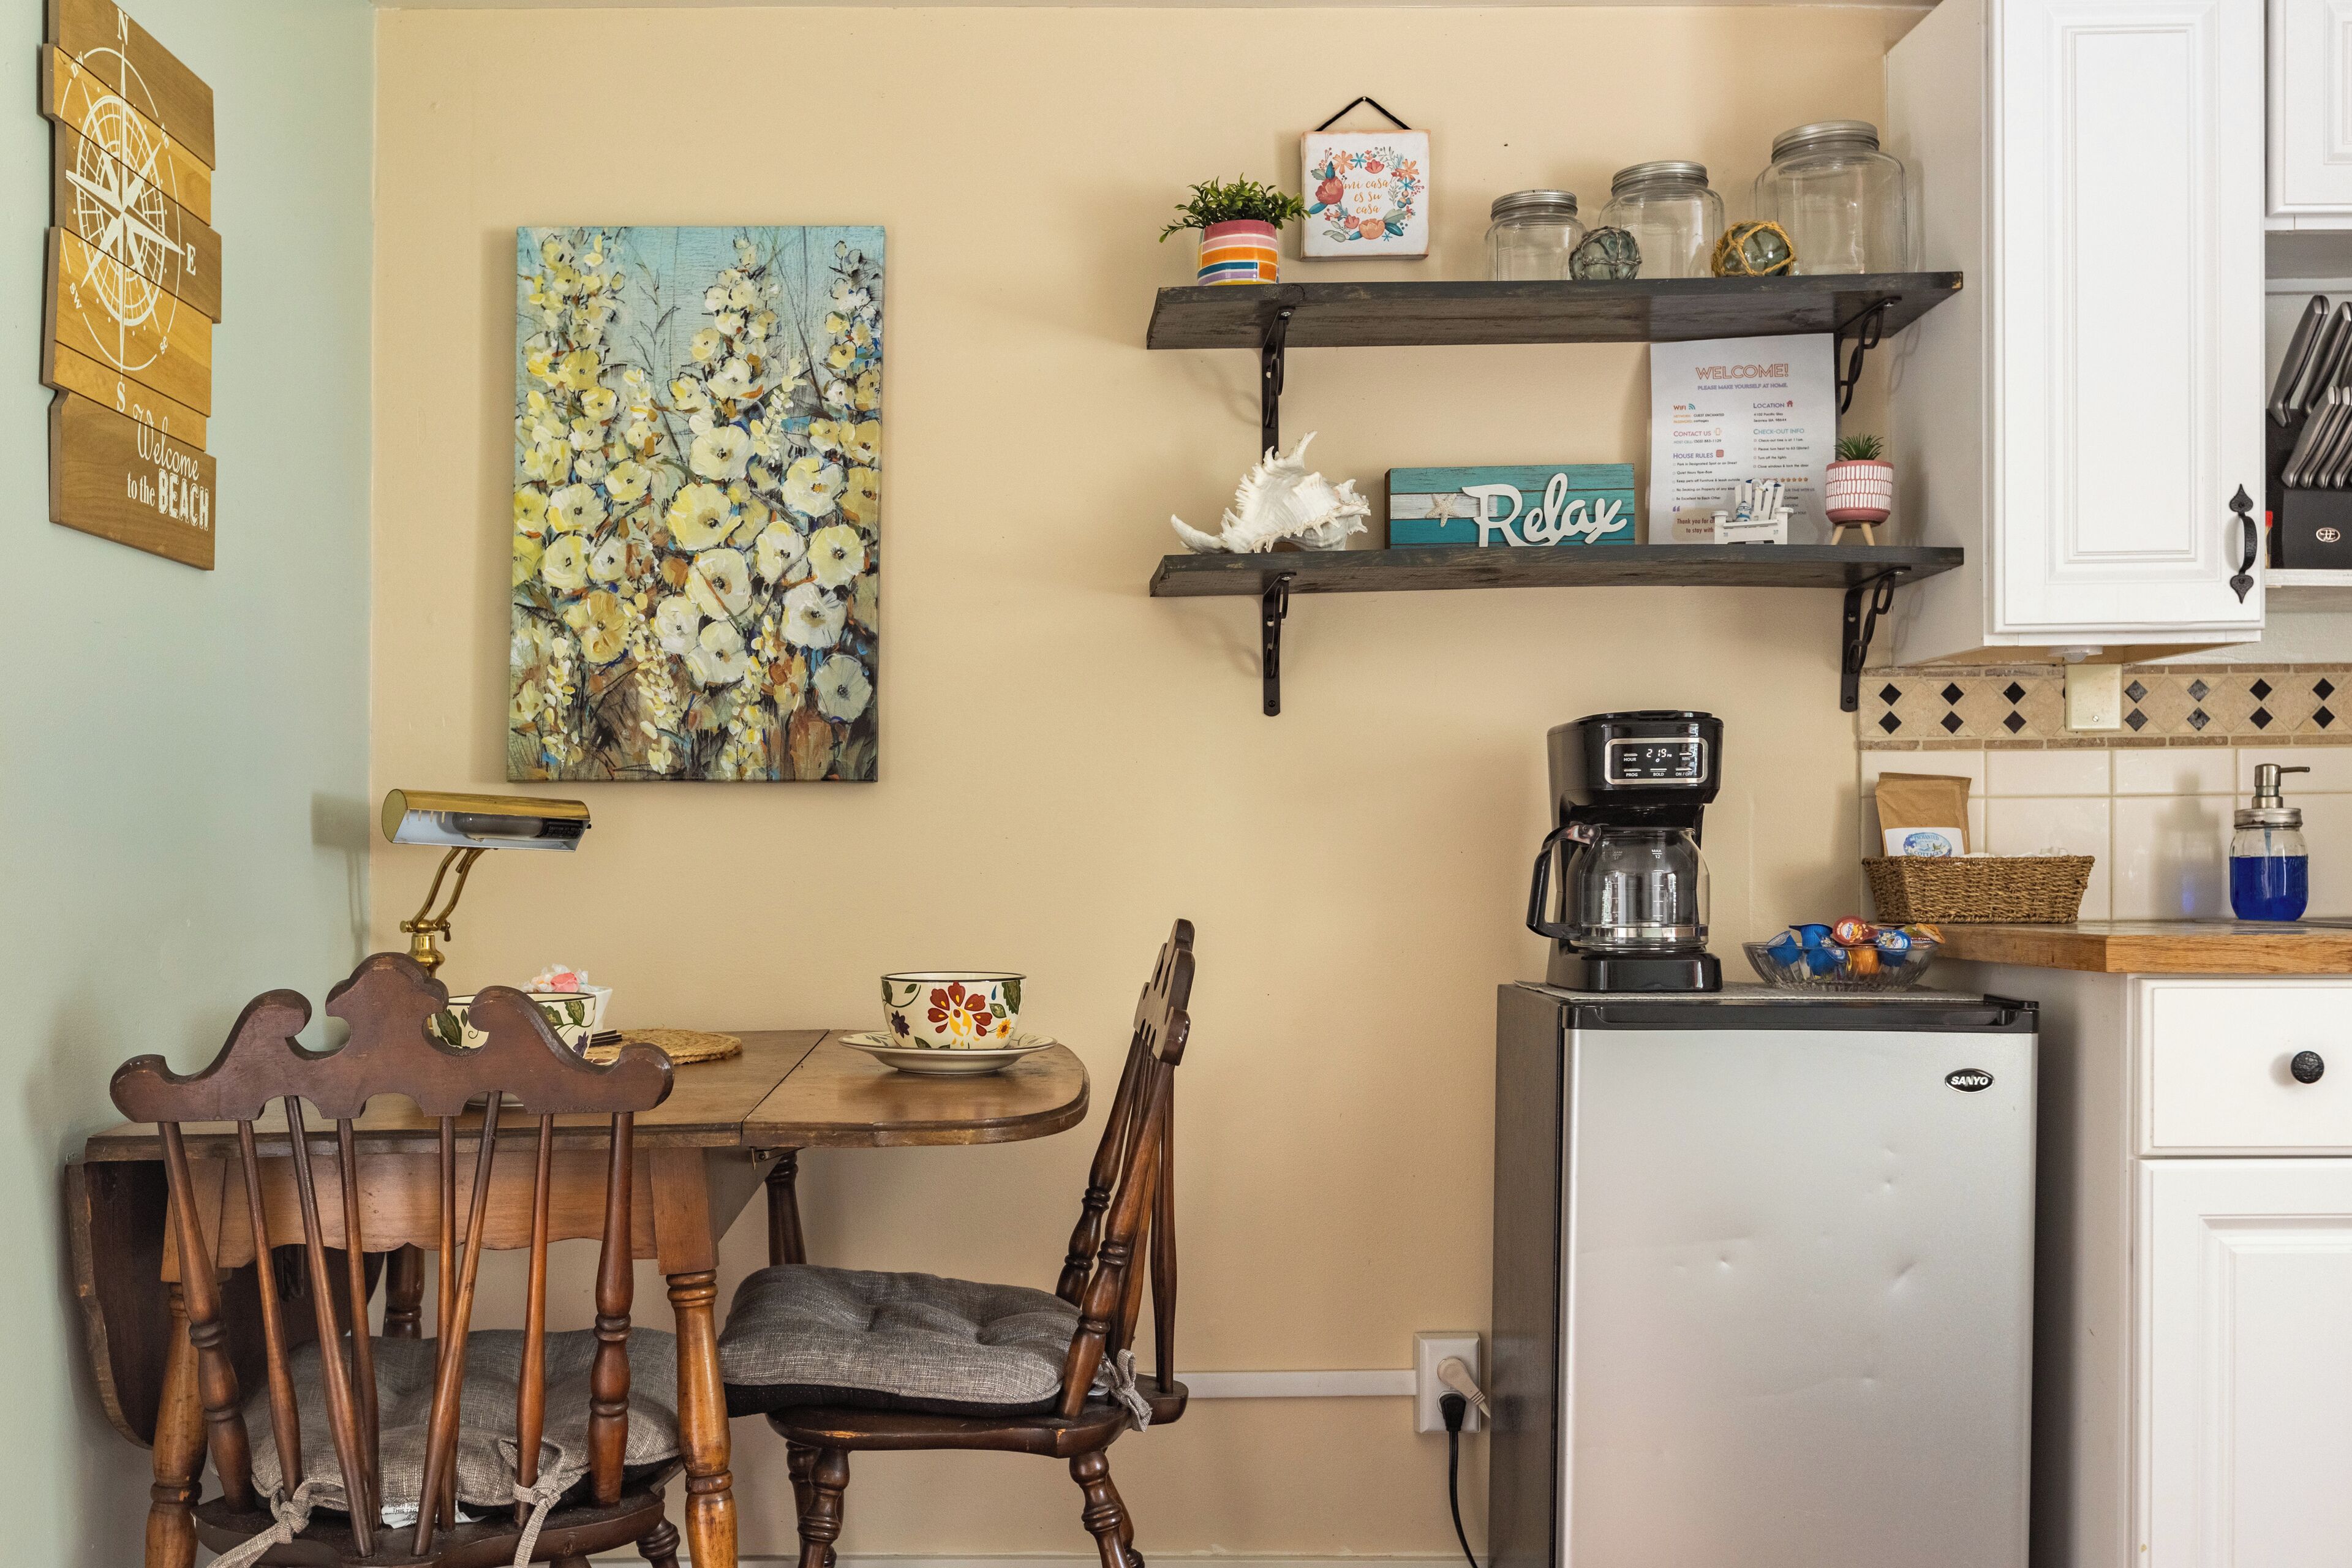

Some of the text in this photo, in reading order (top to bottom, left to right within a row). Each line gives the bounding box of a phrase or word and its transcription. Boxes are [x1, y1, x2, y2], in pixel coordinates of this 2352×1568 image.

[118, 7, 129, 45] N
[1343, 178, 1390, 189] mi casa
[1354, 191, 1382, 203] es su
[1356, 203, 1381, 214] casa
[186, 242, 195, 276] E
[1695, 364, 1789, 380] WELCOME!
[116, 381, 126, 413] S
[133, 404, 199, 481] Welcome
[127, 468, 209, 532] to the BEACH
[1462, 473, 1627, 547] Relax
[1951, 1076, 1989, 1085] SANYO
